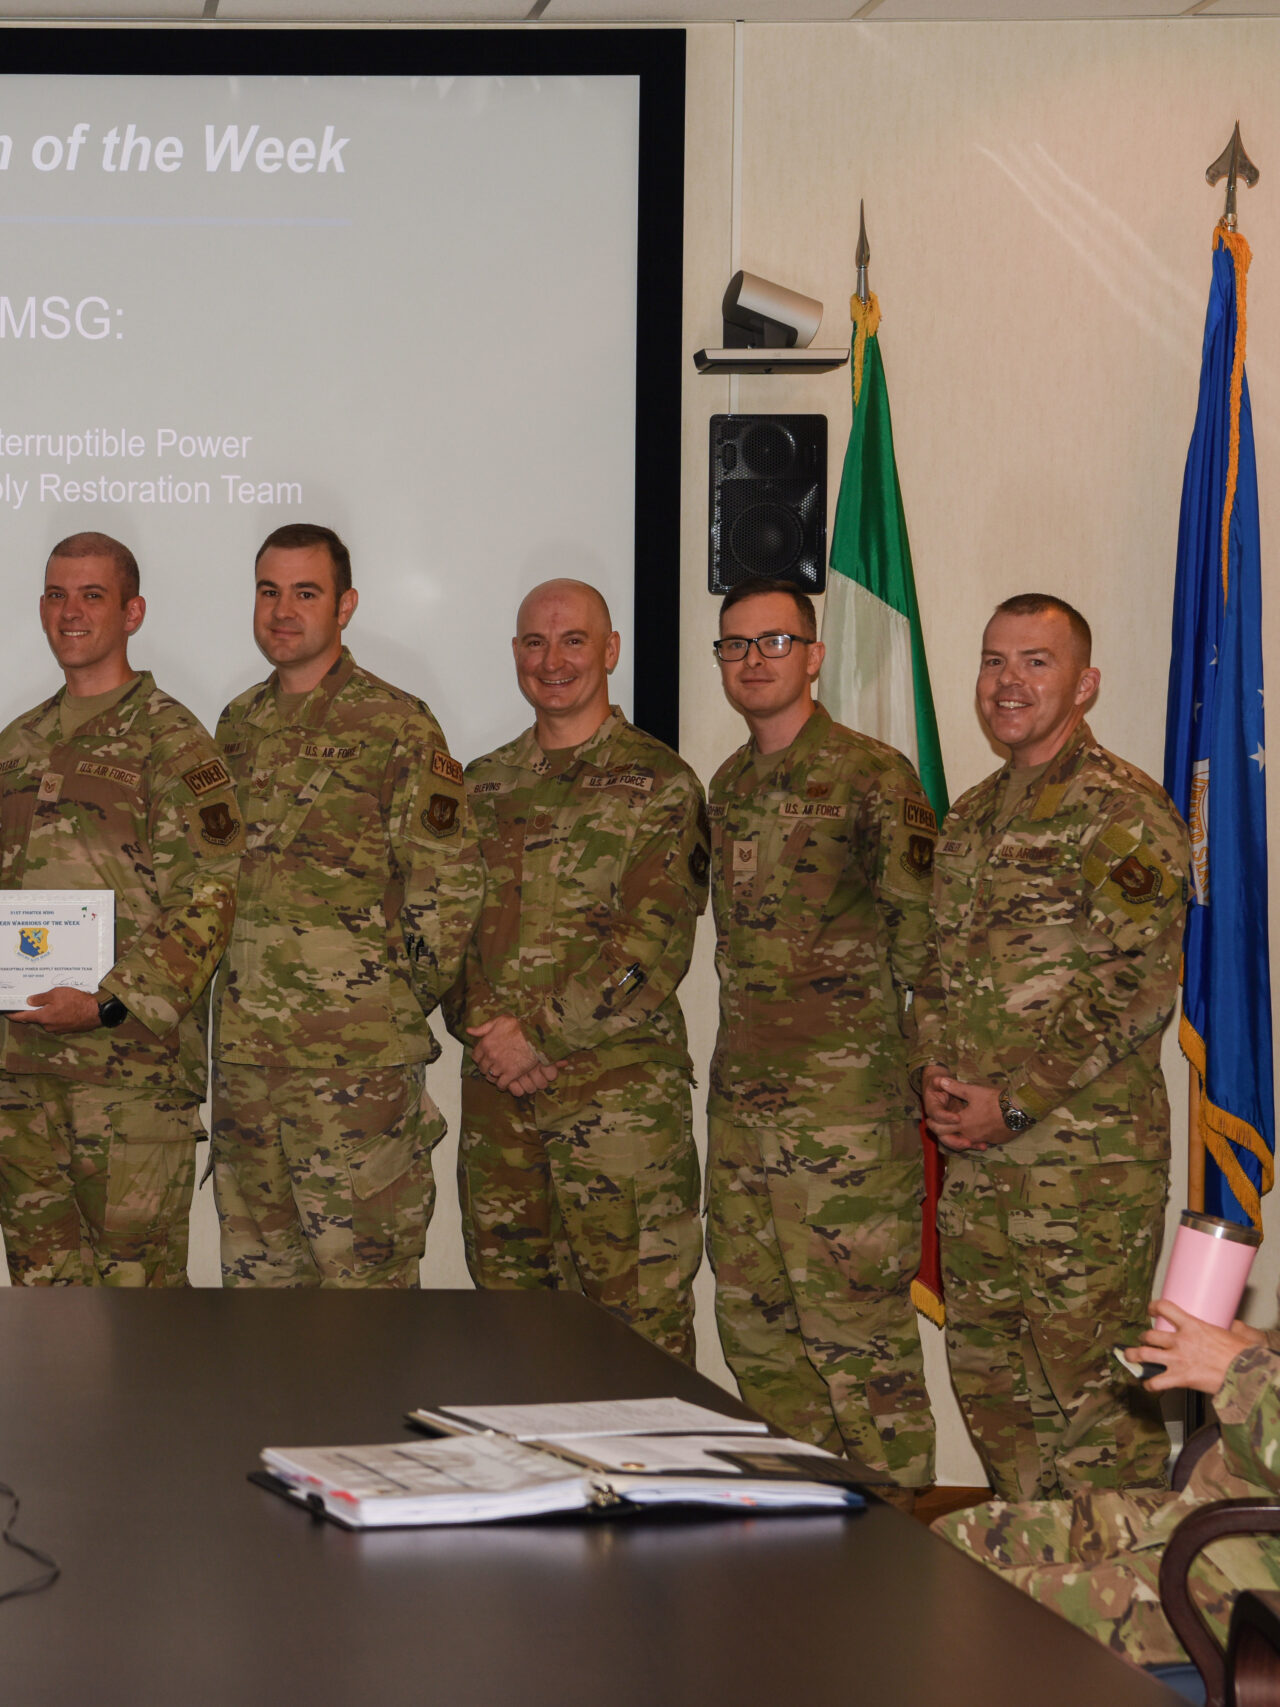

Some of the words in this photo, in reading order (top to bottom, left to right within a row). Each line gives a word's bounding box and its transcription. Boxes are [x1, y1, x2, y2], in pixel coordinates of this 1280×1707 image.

[31, 123, 90, 172] of
[102, 124, 184, 173] the
[205, 125, 351, 173] Week
[0, 296, 123, 340] MSG:
[156, 428, 253, 458] Power
[40, 473, 210, 503] Restoration
[221, 475, 302, 504] Team
[322, 747, 335, 758] AIR
[93, 765, 108, 776] AIR
[109, 768, 136, 785] FORCE
[189, 764, 225, 790] CYBER
[474, 782, 501, 793] BLEVINS
[620, 775, 647, 787] FORCE
[802, 804, 814, 815] AIR
[815, 804, 841, 817] FORCE
[907, 804, 935, 829] CYBER
